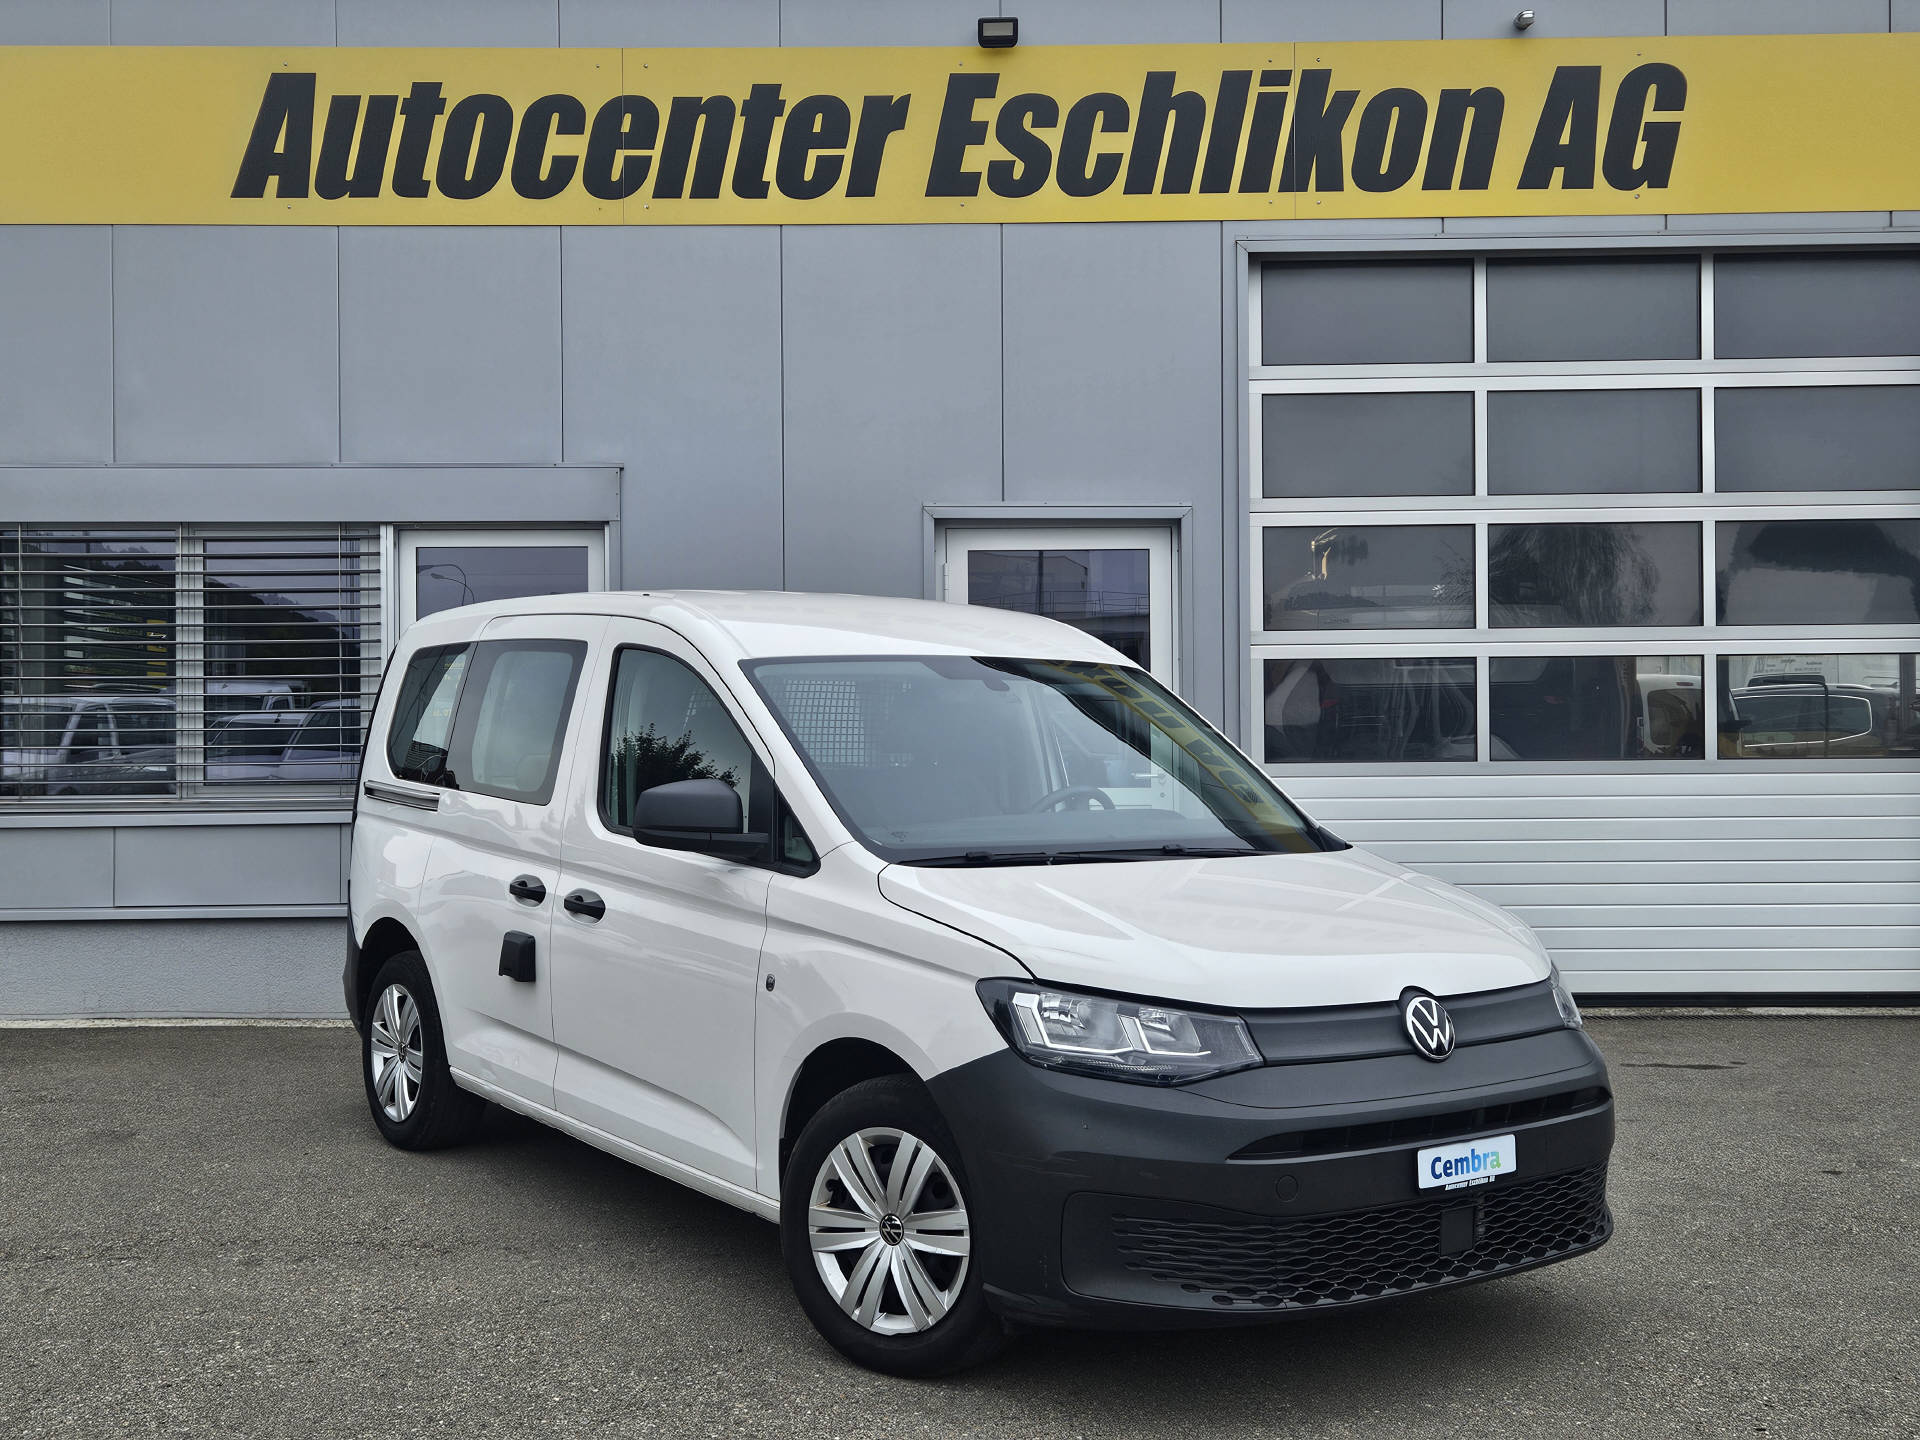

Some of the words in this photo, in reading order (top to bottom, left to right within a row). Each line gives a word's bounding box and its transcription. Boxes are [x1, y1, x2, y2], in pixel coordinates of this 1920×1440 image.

[231, 73, 911, 200] Autocenter
[925, 69, 1504, 198] Eschlikon
[1517, 63, 1687, 190] AG
[1431, 1148, 1501, 1179] Cembra
